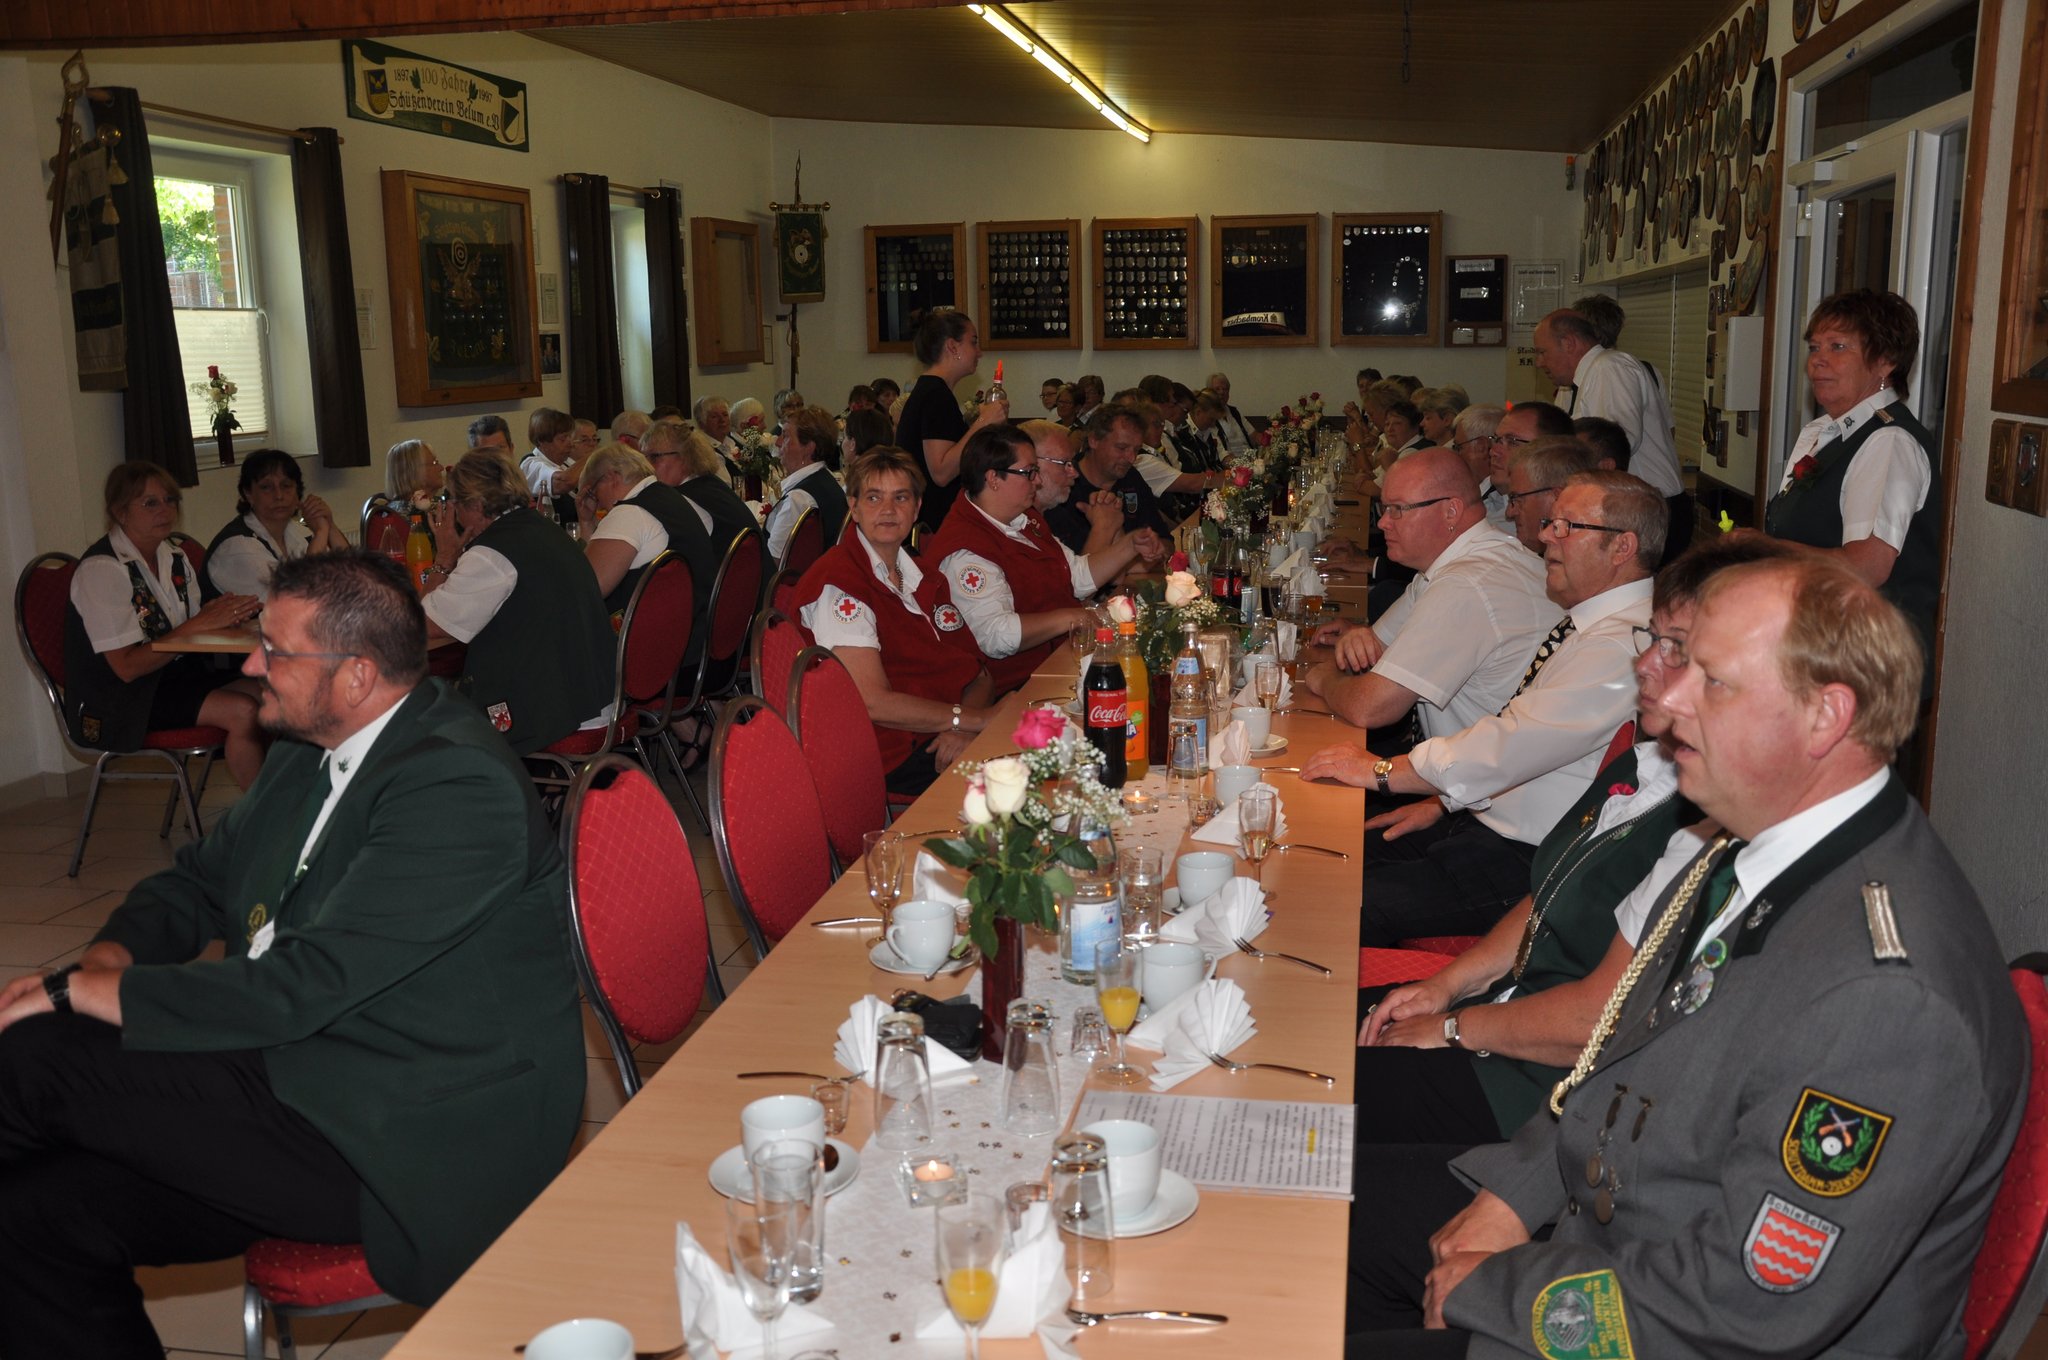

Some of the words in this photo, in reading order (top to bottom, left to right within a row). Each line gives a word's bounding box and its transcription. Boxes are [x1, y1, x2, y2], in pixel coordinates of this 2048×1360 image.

[393, 69, 409, 82] 1897
[421, 68, 438, 85] 100
[440, 67, 469, 93] Jahre
[478, 88, 493, 103] 1997
[388, 89, 454, 114] Schützenverein
[457, 100, 485, 125] Belum
[1767, 1196, 1838, 1235] Schießclub
